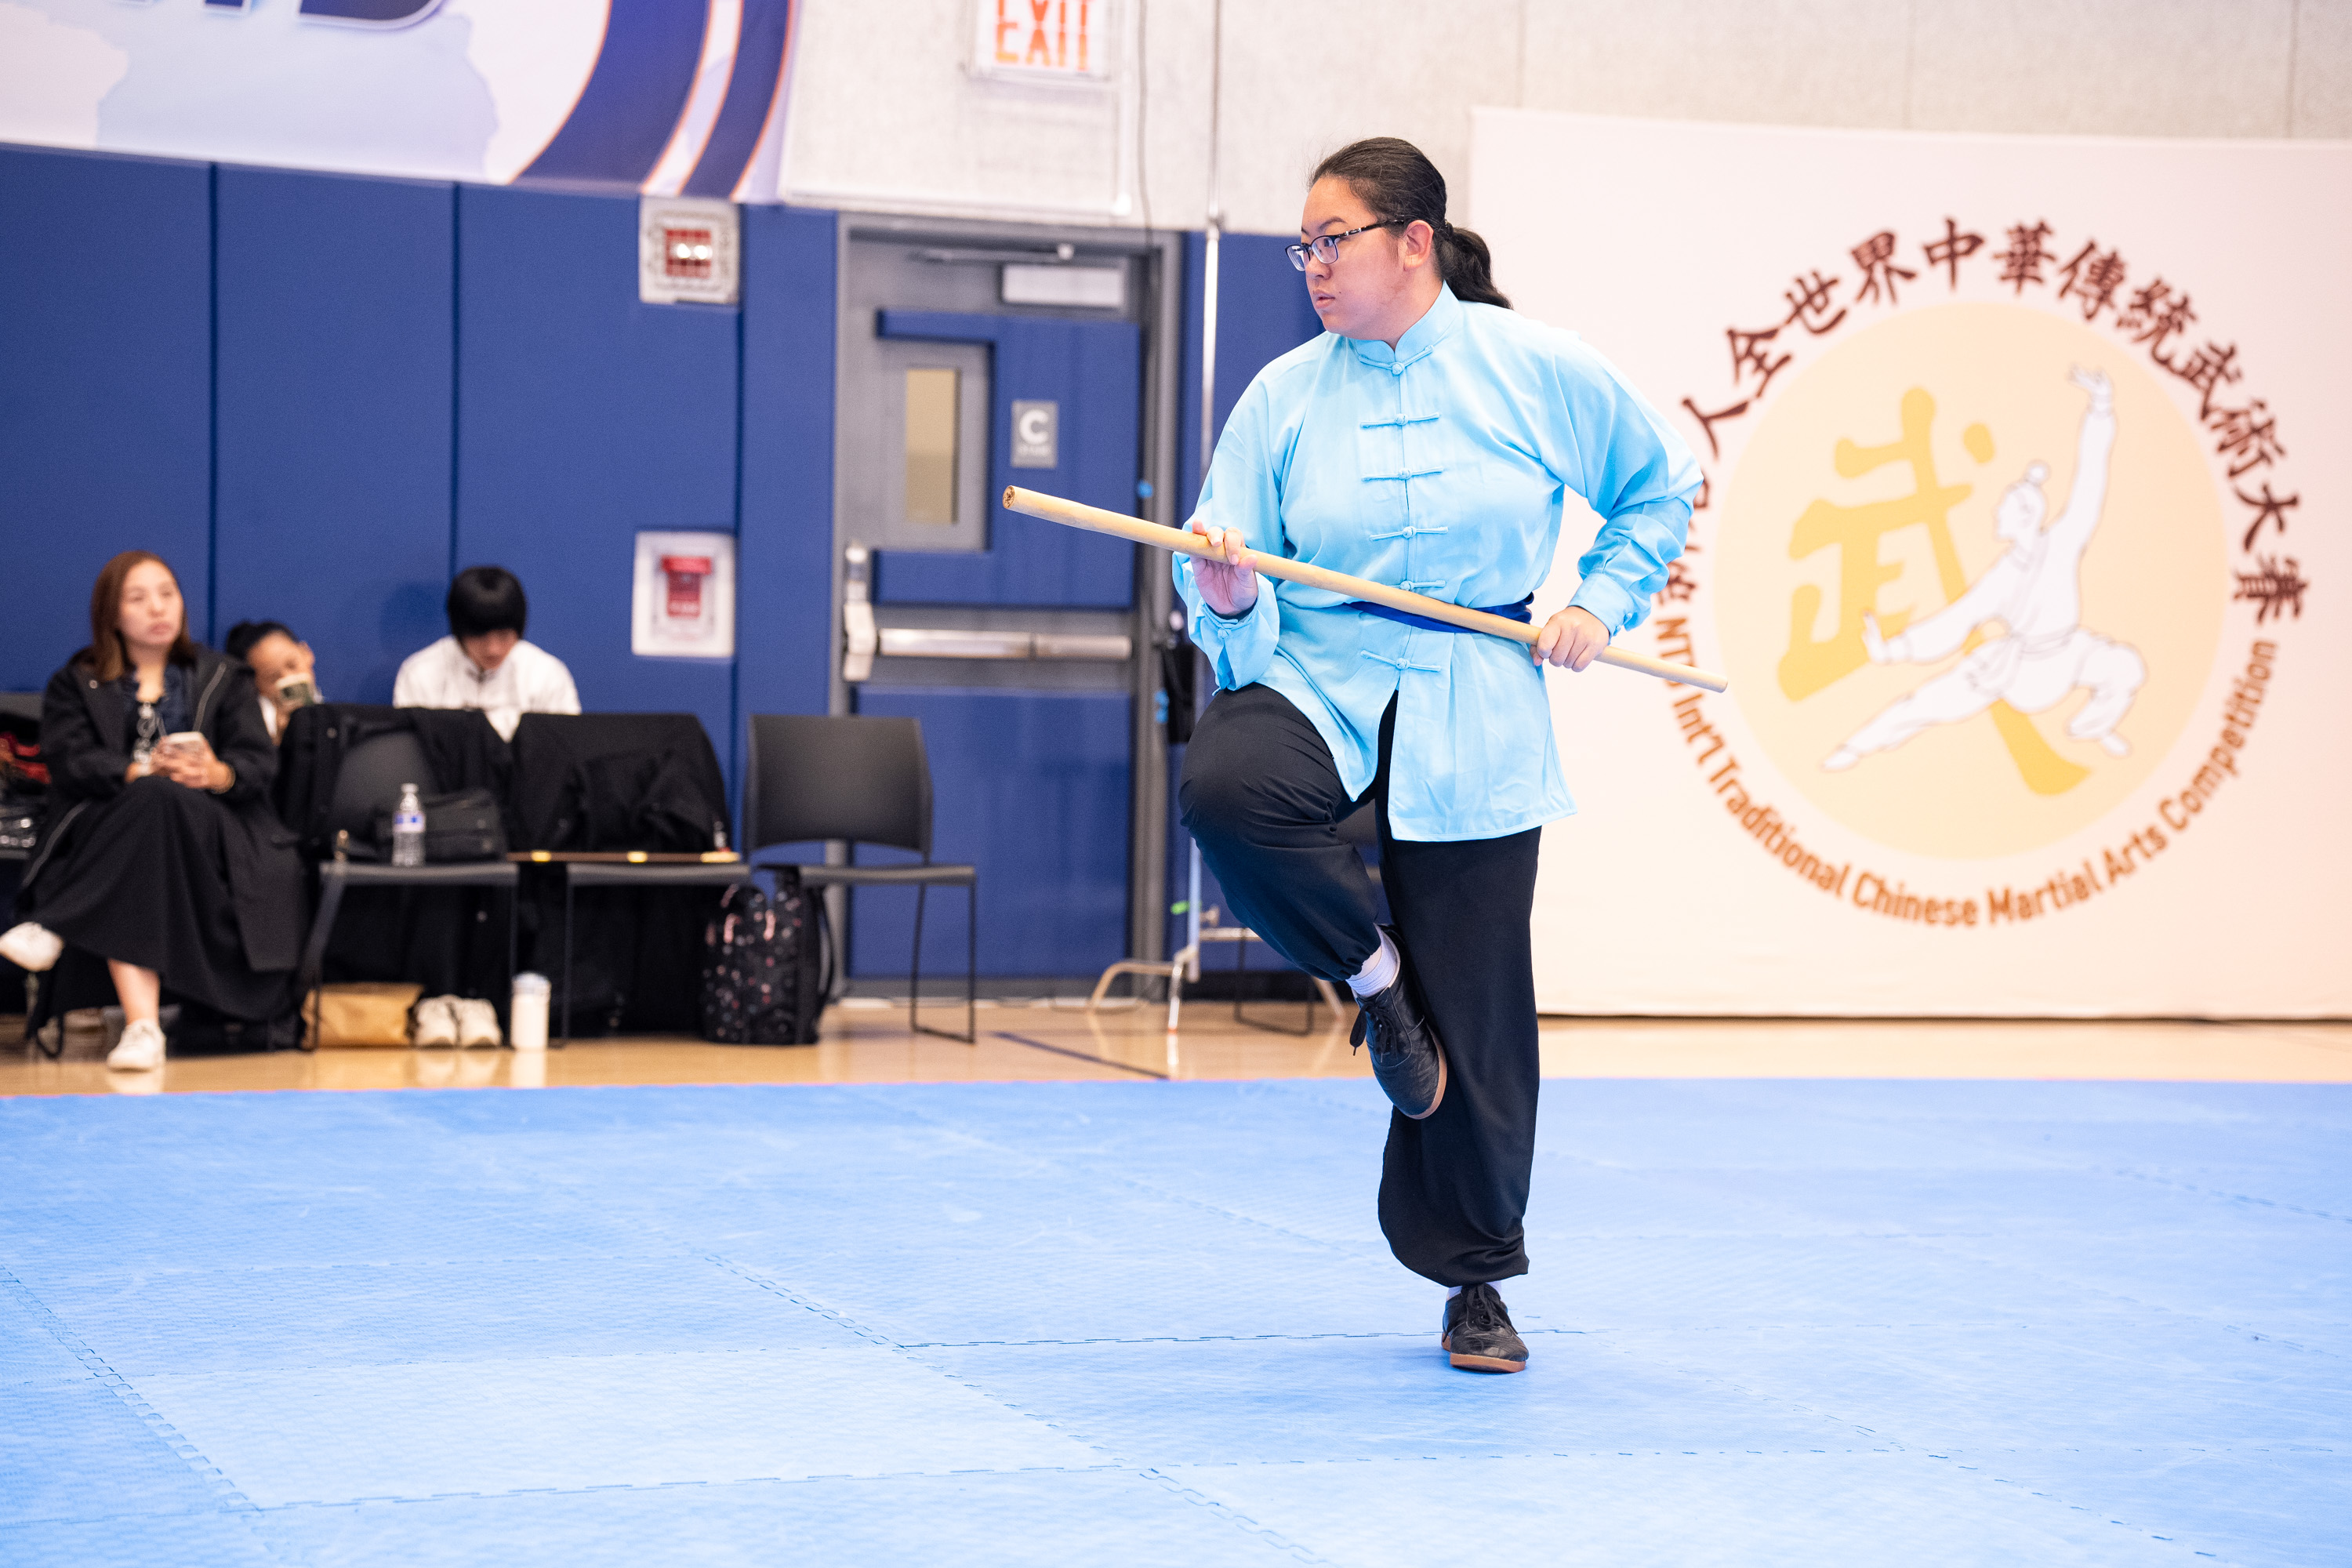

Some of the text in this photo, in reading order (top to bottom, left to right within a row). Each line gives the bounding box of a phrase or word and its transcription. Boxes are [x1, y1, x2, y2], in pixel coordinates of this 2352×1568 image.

[996, 0, 1089, 71] EXIT
[1019, 409, 1049, 445] C
[1657, 215, 2311, 625] 人全世界中華傳統武術大賽
[1654, 616, 1697, 688] NT
[1708, 755, 1852, 898] Traditional
[1852, 872, 1978, 926] Chinese
[1987, 858, 2103, 925] Martial
[2102, 823, 2168, 884] Arts
[2158, 639, 2279, 832] Competition
